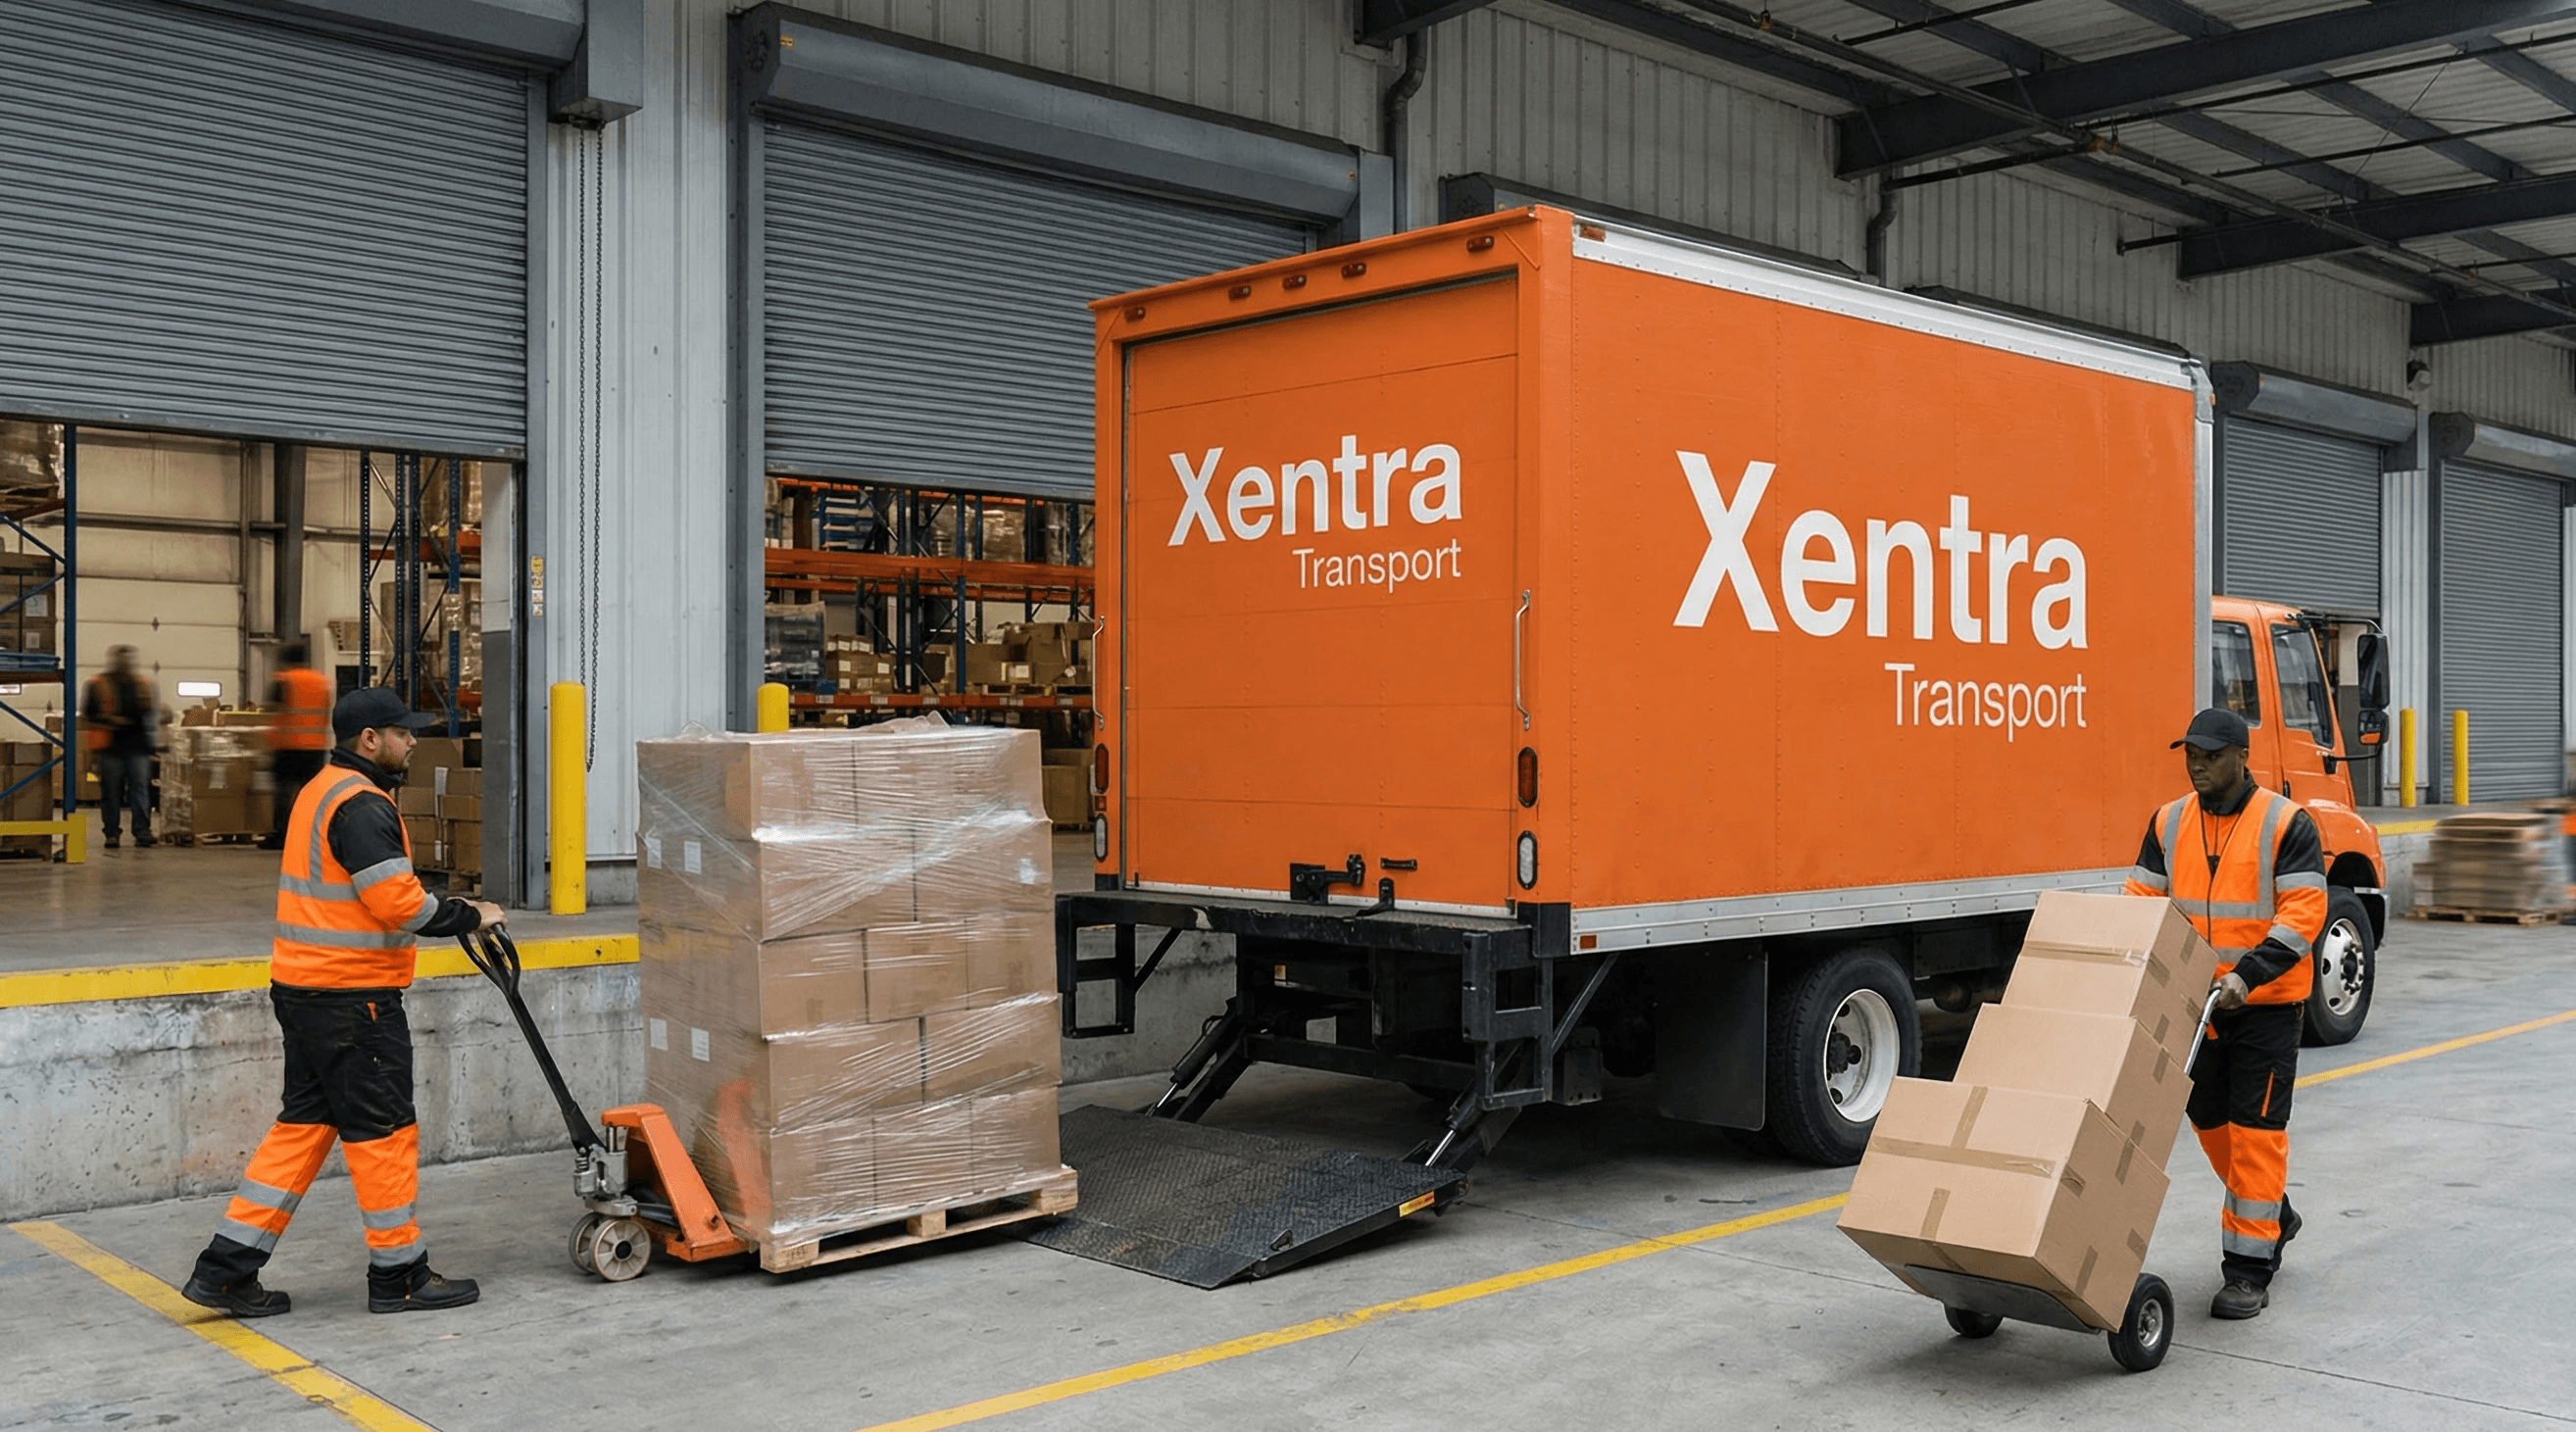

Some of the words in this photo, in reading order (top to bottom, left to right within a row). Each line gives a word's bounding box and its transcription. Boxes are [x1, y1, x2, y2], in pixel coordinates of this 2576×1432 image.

[1167, 434, 1462, 546] Xentra
[1292, 538, 1461, 594] Transport
[1672, 450, 2089, 650] Xentra
[1884, 663, 2088, 742] Transport
